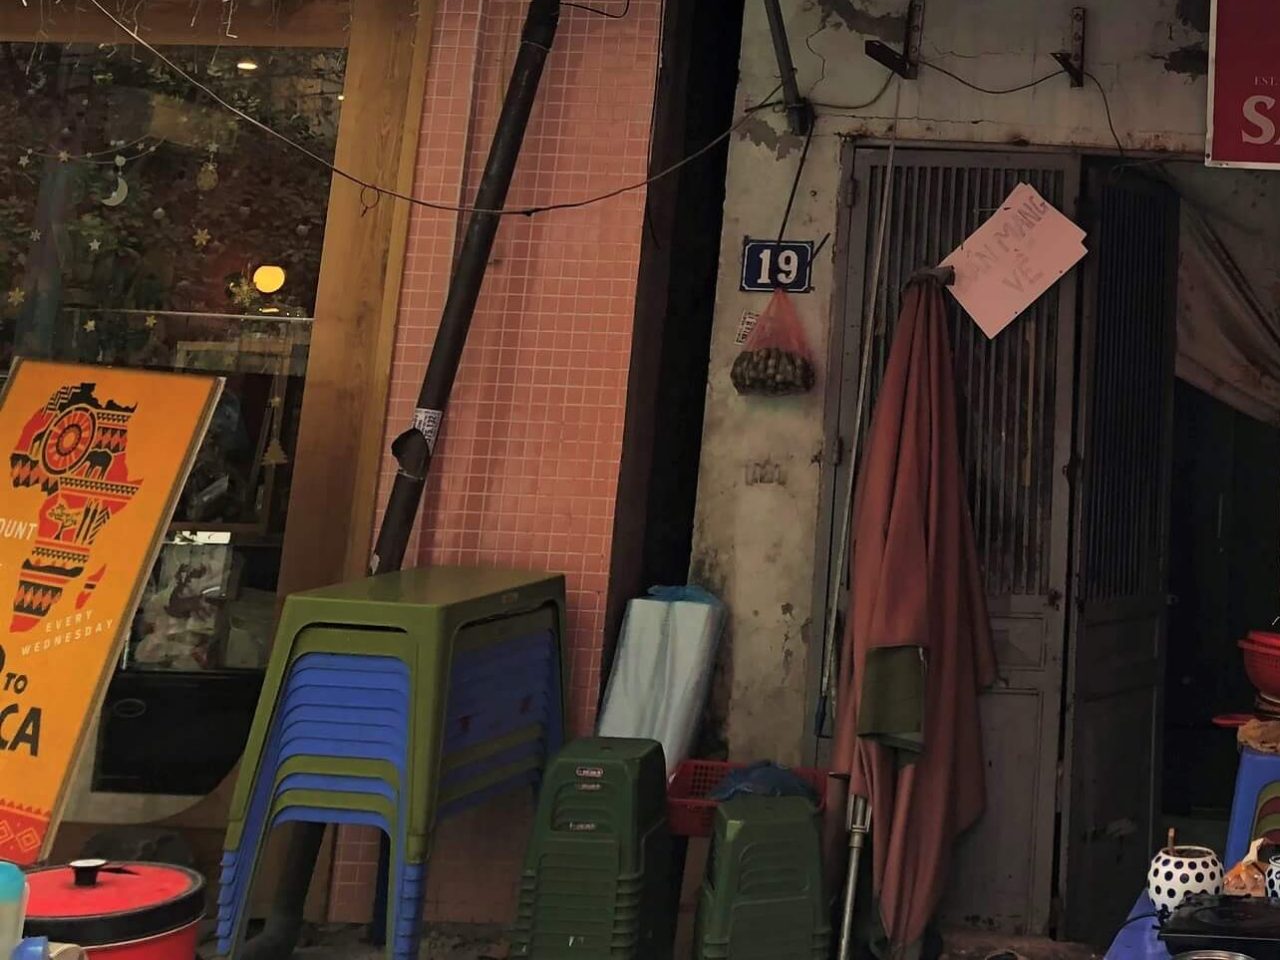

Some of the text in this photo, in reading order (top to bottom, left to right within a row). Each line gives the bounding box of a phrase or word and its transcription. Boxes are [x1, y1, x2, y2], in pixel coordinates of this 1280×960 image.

[756, 248, 799, 285] 19
[46, 609, 94, 633] EVERY
[21, 619, 114, 656] WEDNESDAY
[3, 672, 28, 694] TO
